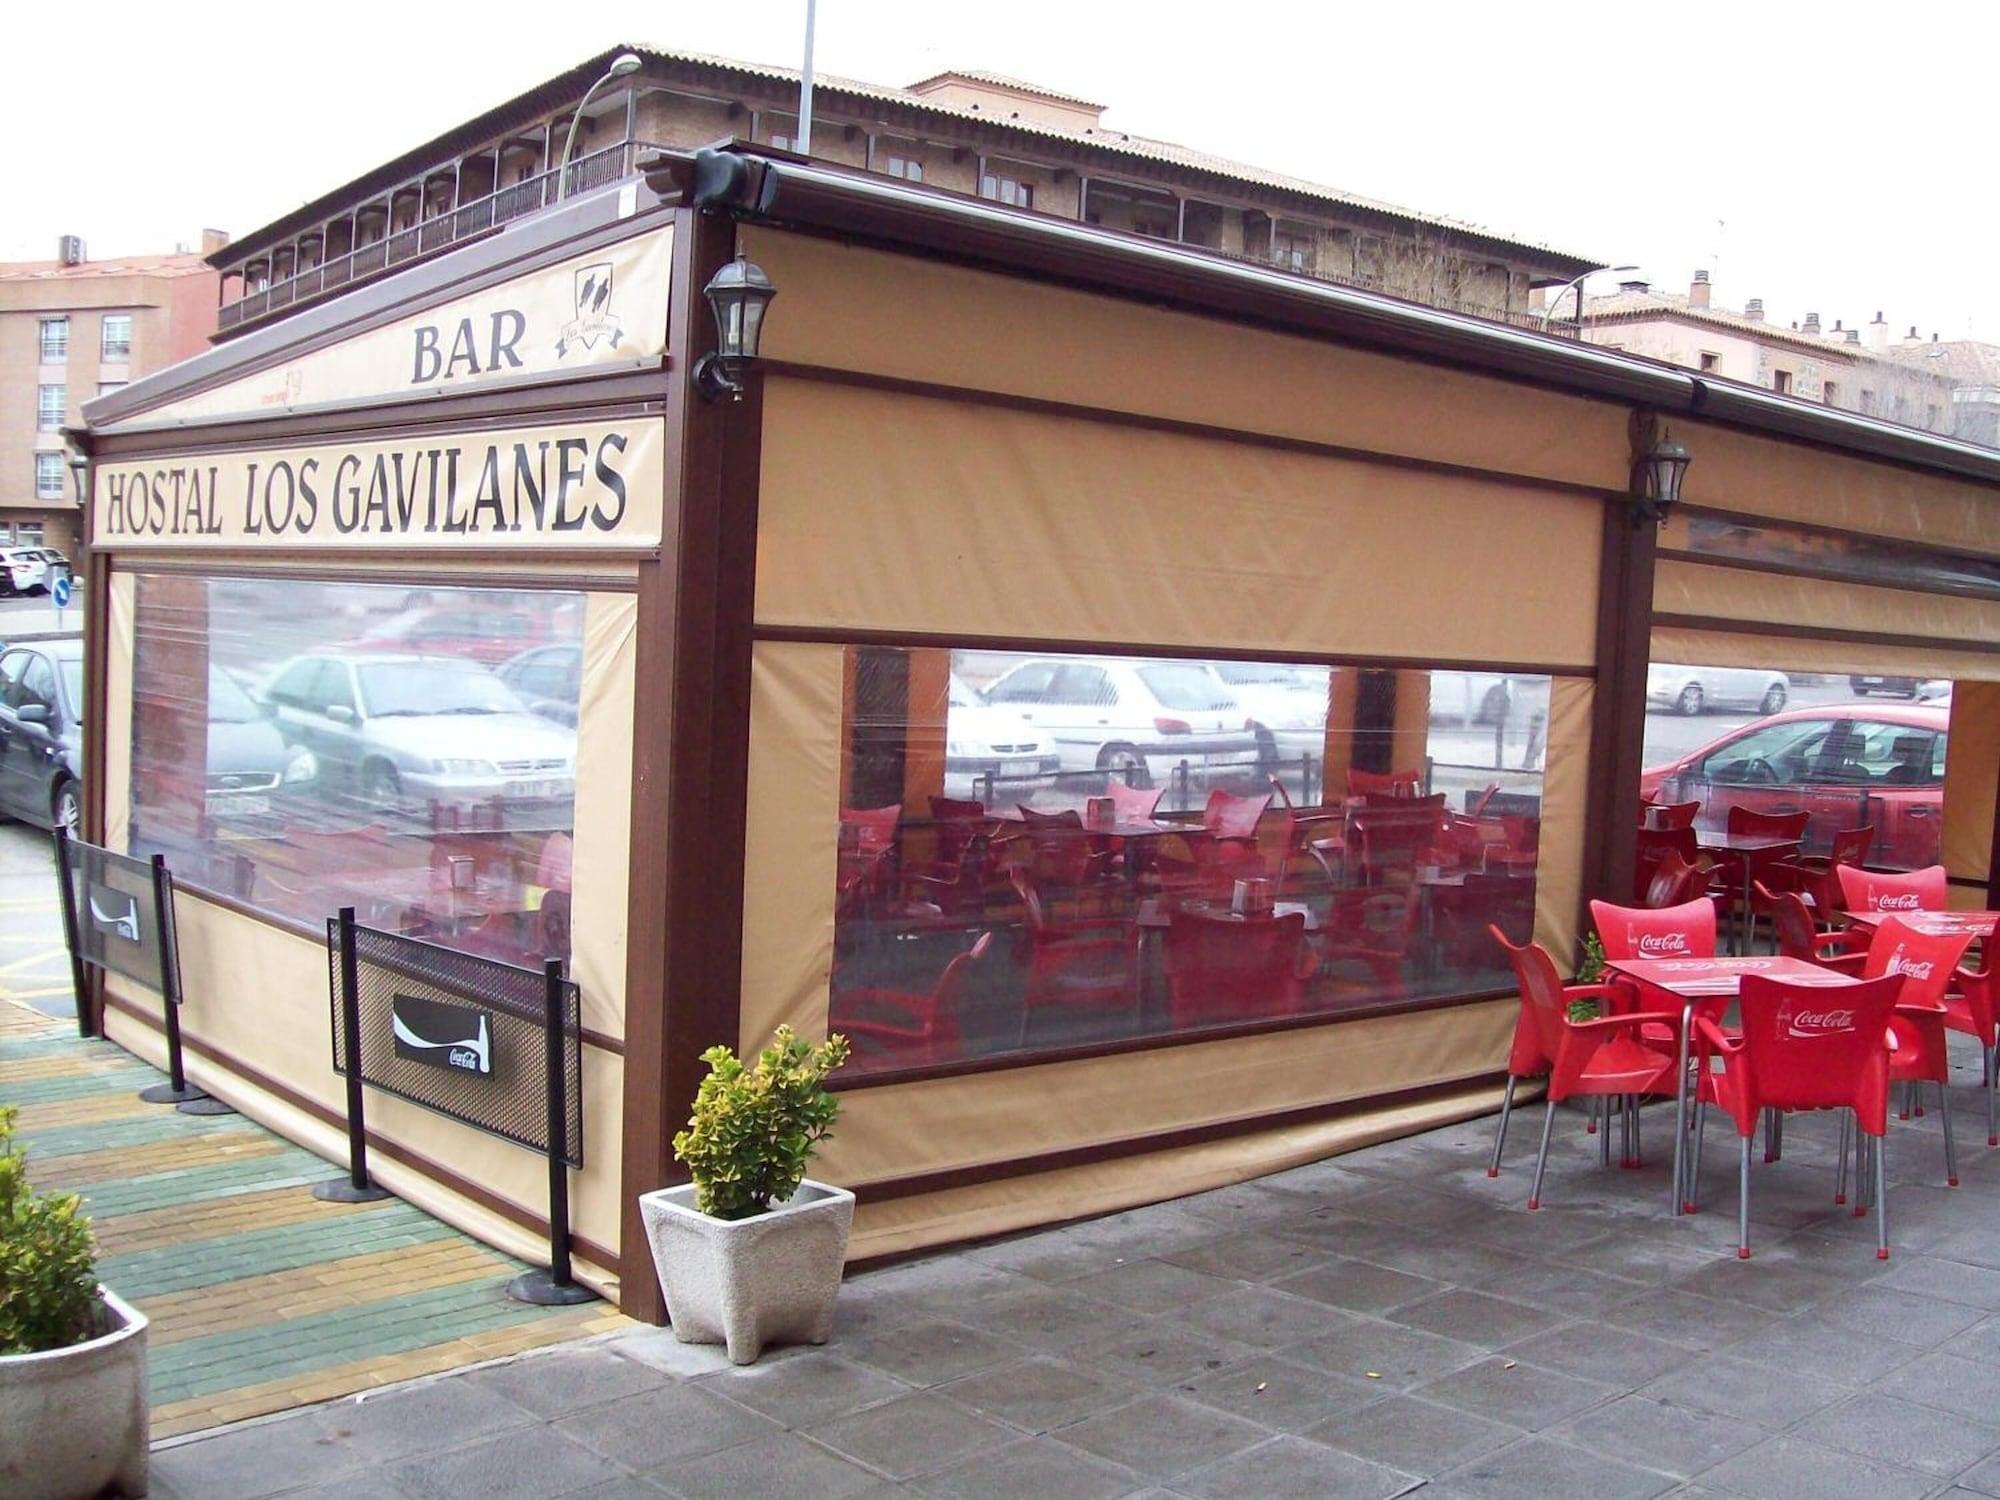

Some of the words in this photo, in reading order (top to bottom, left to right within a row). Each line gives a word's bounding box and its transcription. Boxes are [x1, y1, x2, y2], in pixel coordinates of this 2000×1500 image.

[411, 308, 527, 384] BAR
[106, 466, 224, 536] HOSTAL
[243, 458, 320, 536] LOS
[333, 432, 629, 536] GAVILANES
